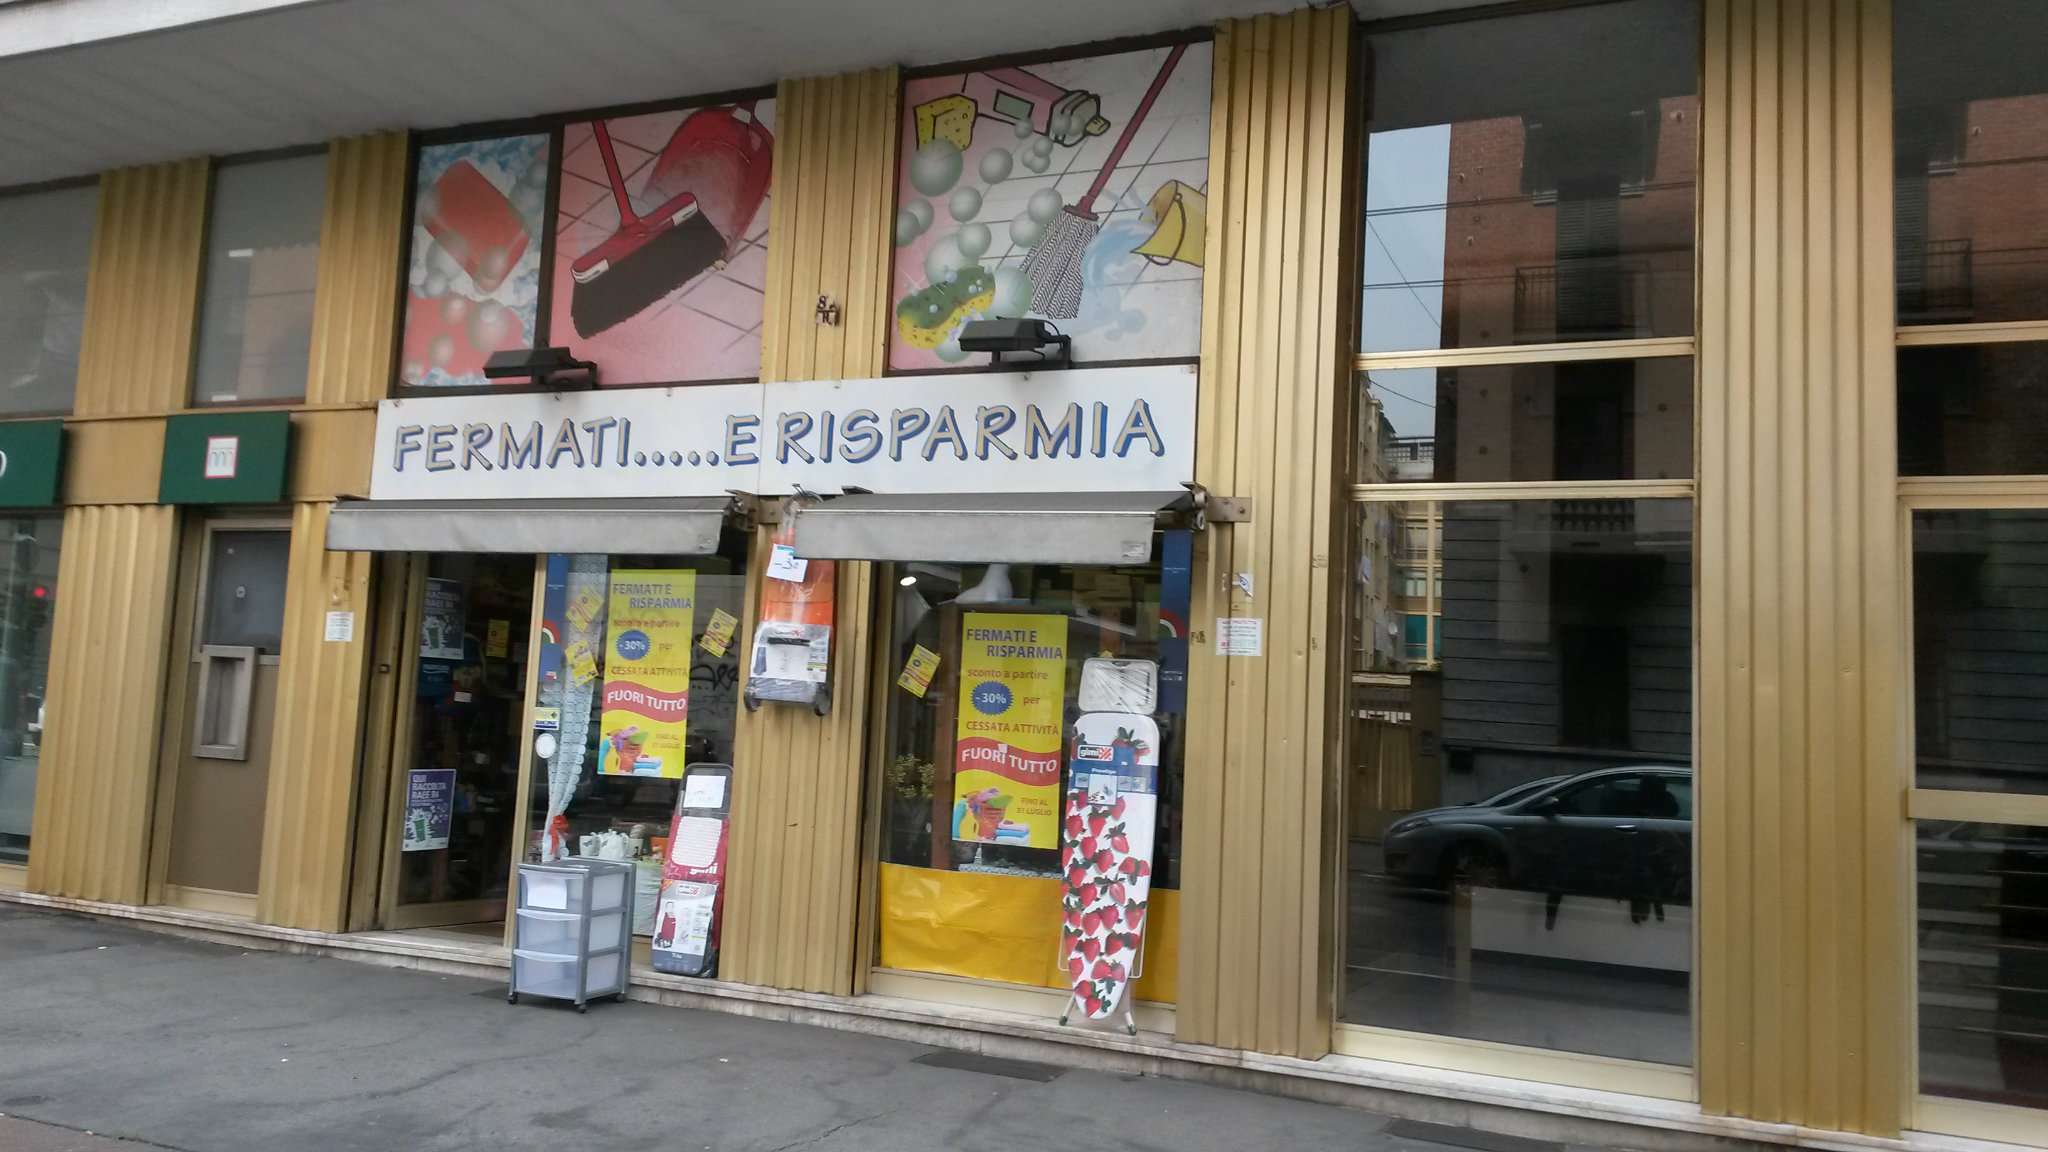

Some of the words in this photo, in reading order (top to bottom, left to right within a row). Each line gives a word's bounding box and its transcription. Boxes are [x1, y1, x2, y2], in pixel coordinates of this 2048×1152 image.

[776, 398, 1165, 464] RISPARMIA
[630, 597, 692, 609] RISPARMIA
[966, 628, 1026, 643] FERMATI
[1030, 630, 1038, 643] E
[986, 645, 1064, 659] RISPARMIA
[607, 690, 644, 705] FUORI
[646, 695, 686, 711] TUTTO
[1023, 697, 1041, 706] per
[966, 721, 1010, 733] CESSATA
[961, 747, 1006, 765] FUORI
[1008, 754, 1058, 774] TUTTO
